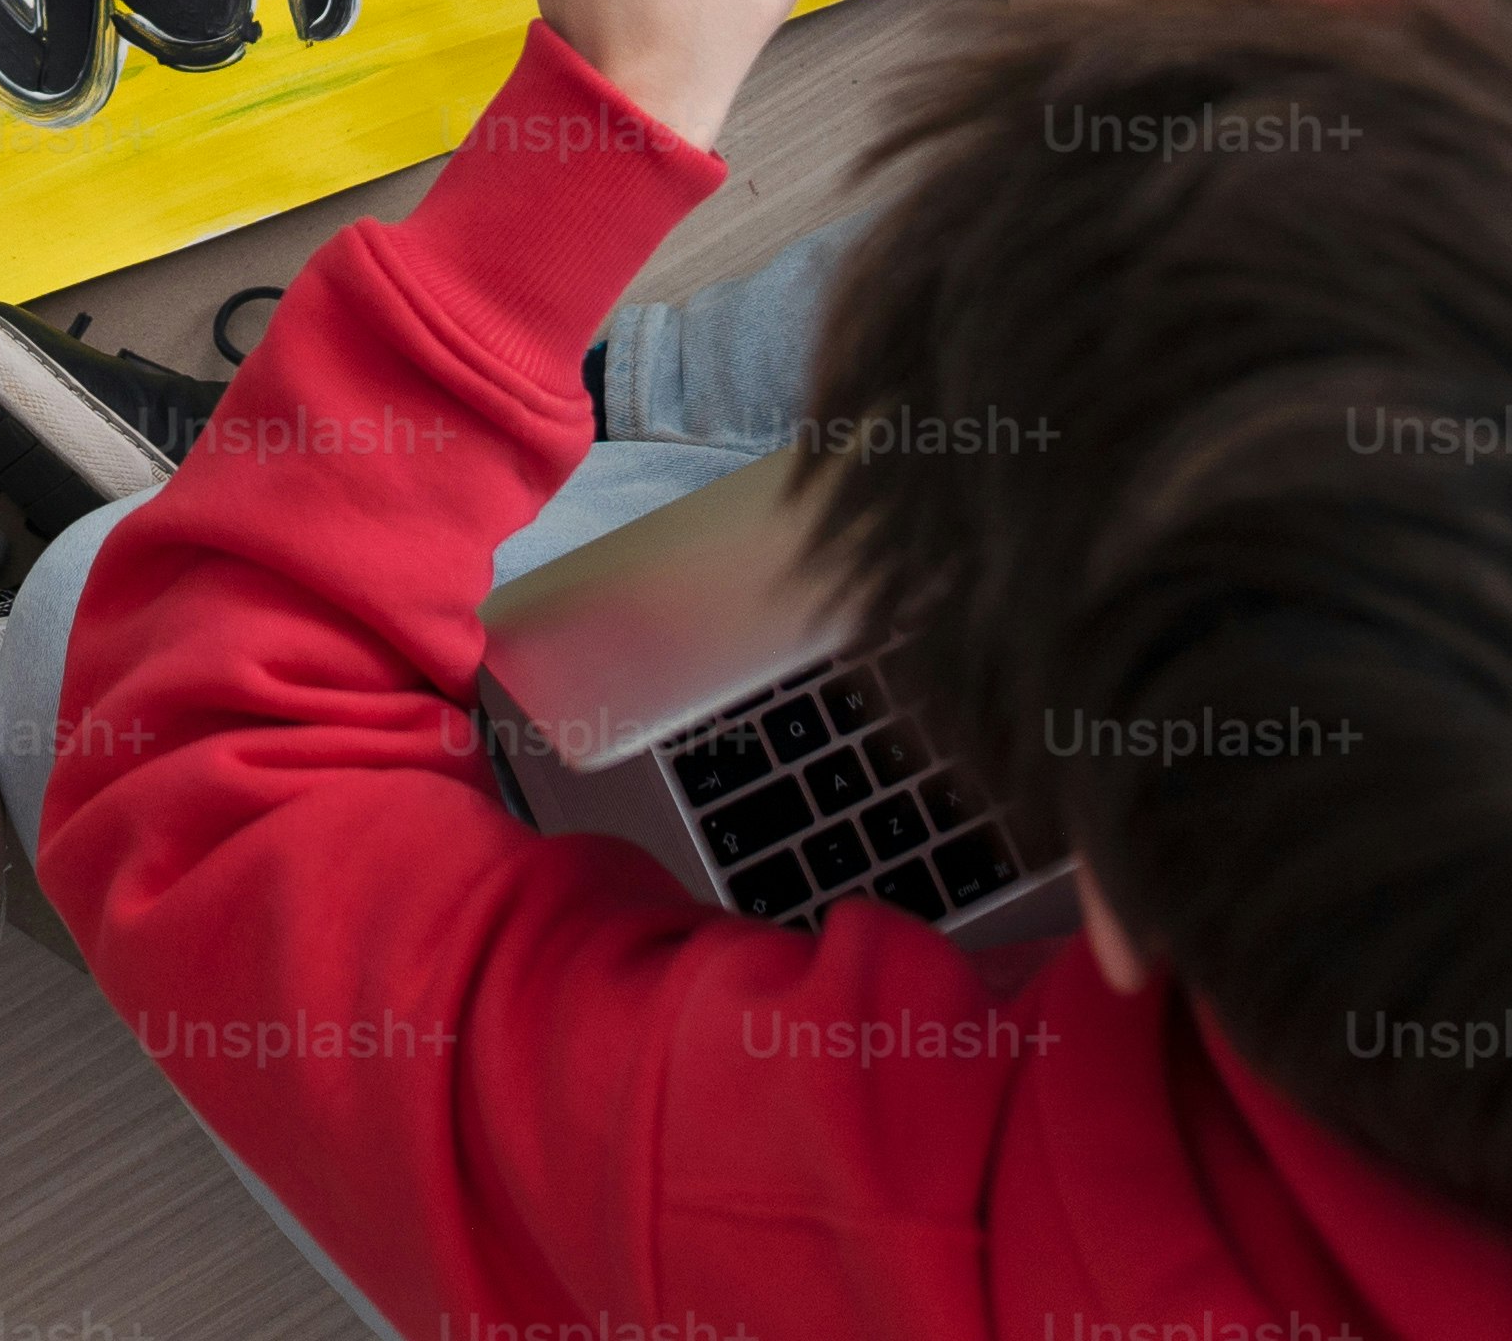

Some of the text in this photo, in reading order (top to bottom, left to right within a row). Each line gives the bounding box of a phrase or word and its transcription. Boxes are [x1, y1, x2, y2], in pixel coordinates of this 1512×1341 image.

[789, 692, 864, 738] Q W
[834, 745, 904, 792] A S
[888, 791, 961, 836] Z X
[957, 879, 981, 898] cmd
